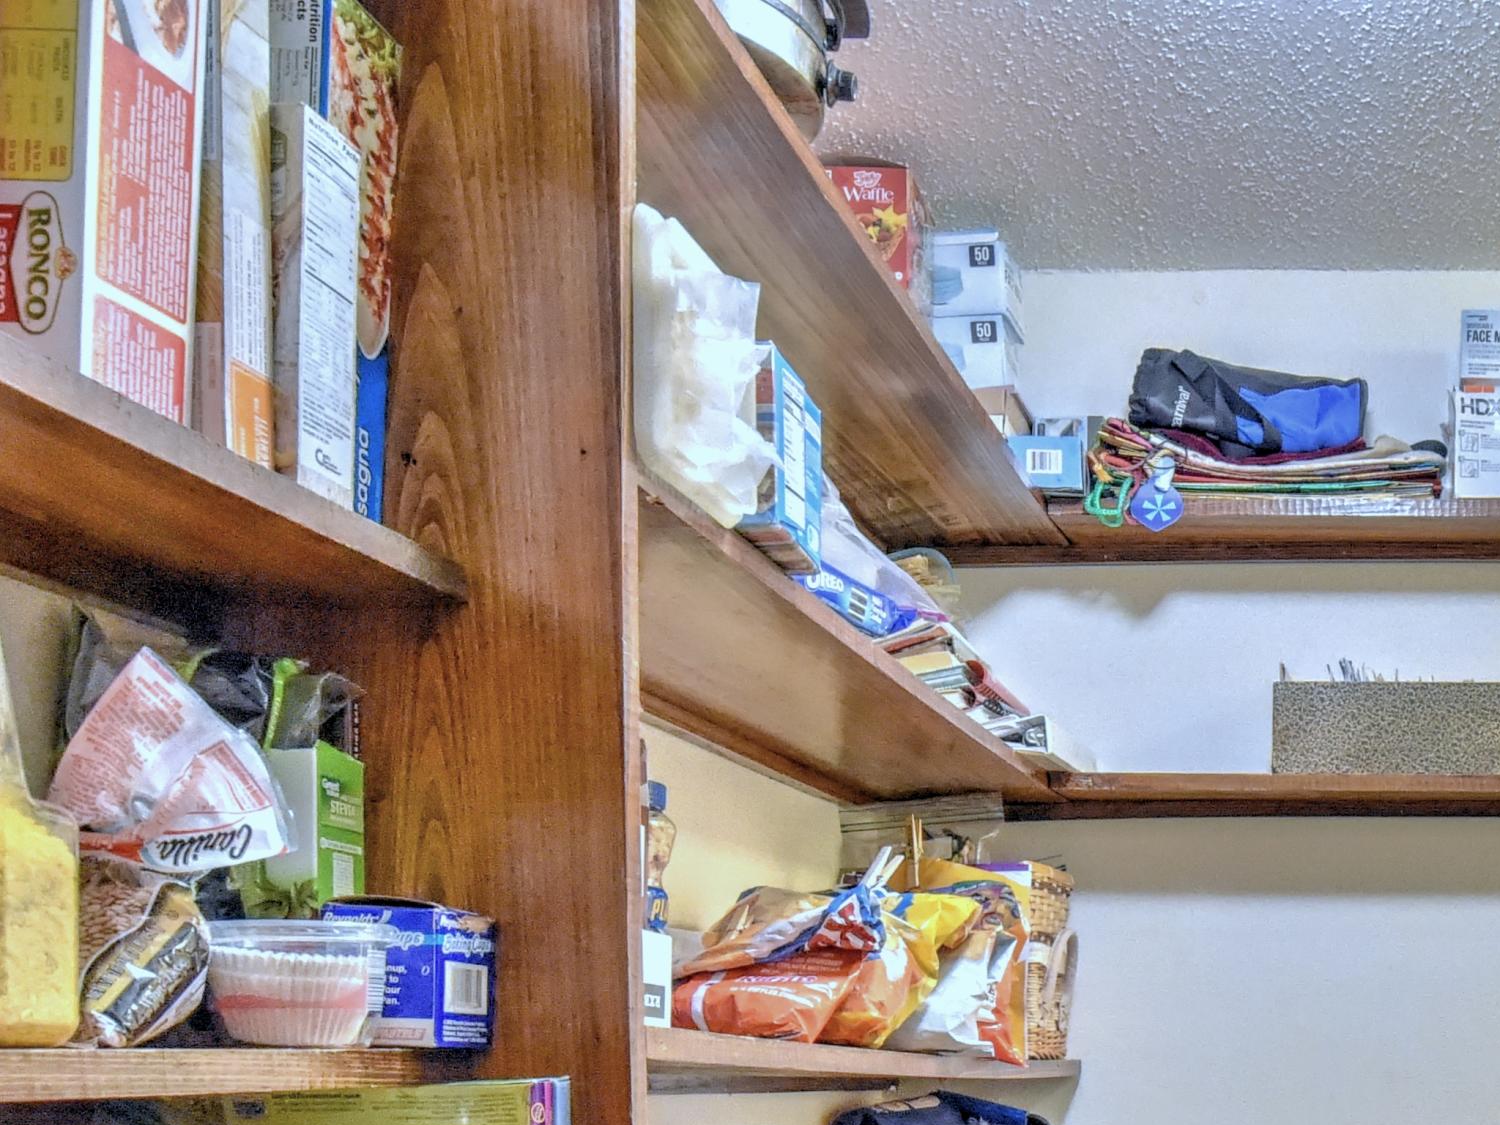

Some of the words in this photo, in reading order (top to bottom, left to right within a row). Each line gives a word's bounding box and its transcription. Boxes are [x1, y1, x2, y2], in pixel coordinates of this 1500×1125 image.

[309, 0, 320, 43] utrition
[842, 186, 895, 202] Waffle
[974, 246, 990, 262] 50
[26, 207, 50, 320] RONCO
[976, 323, 992, 338] 50
[1466, 329, 1492, 343] FACE
[357, 427, 372, 518] sagna
[329, 800, 357, 818] STEVIA
[155, 823, 254, 867] Canilla
